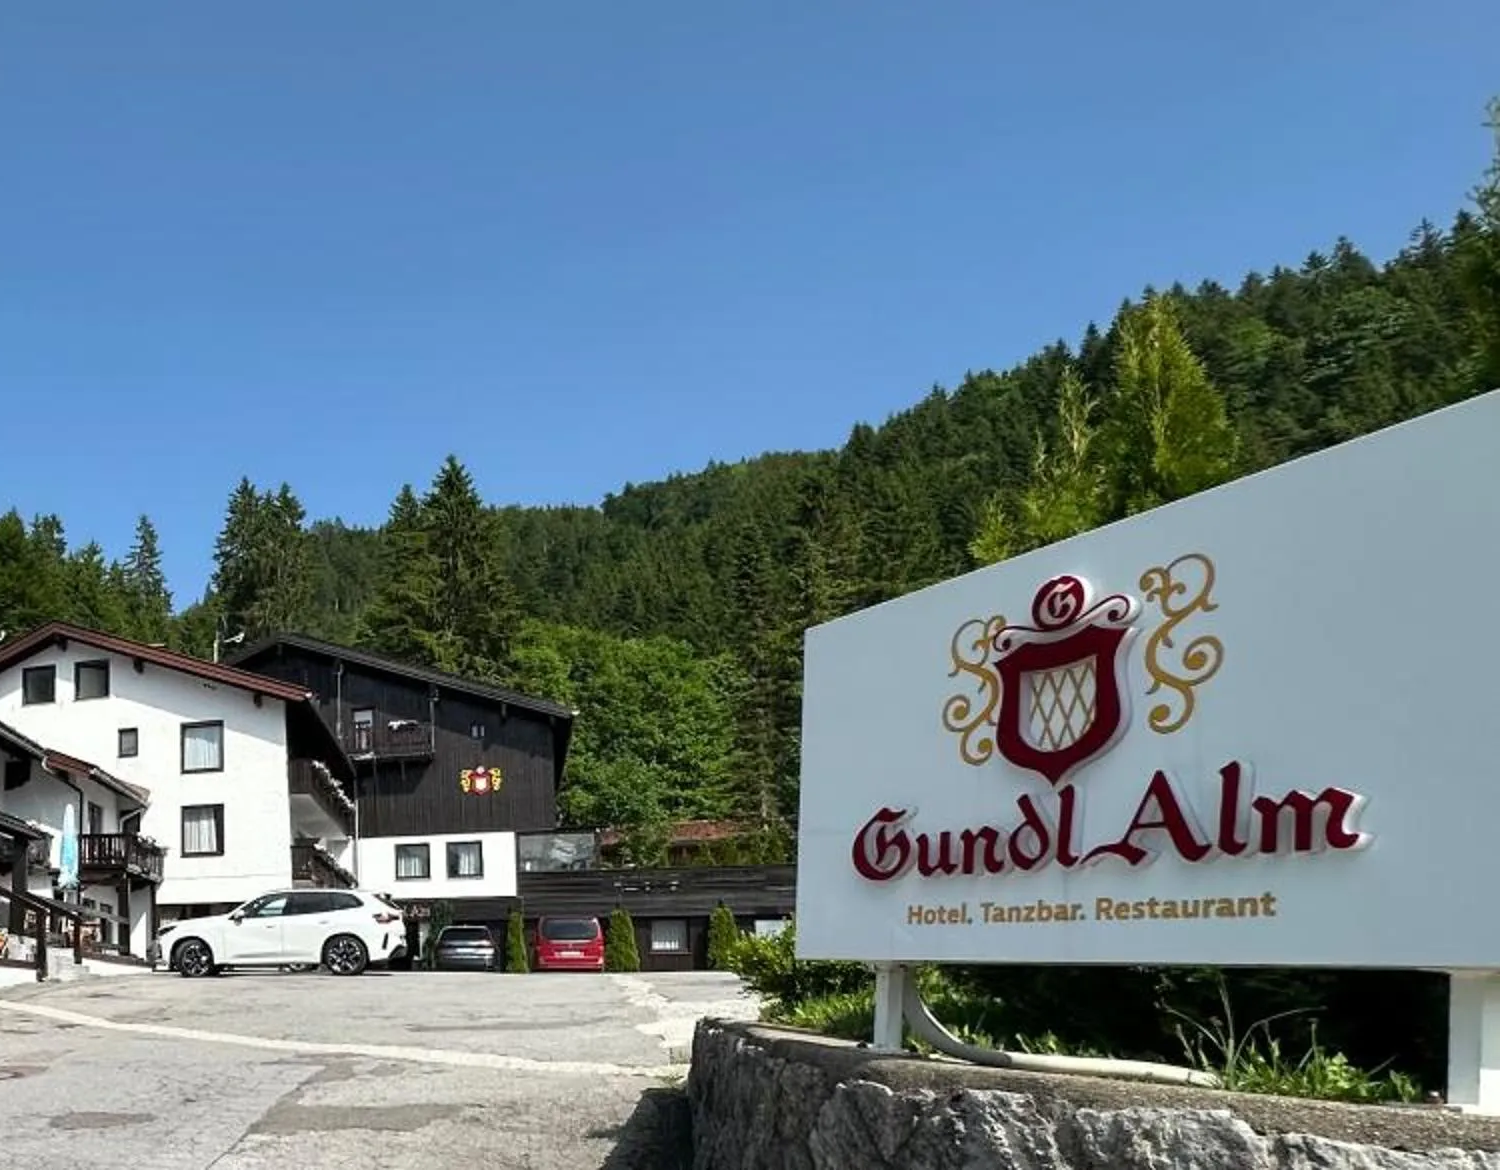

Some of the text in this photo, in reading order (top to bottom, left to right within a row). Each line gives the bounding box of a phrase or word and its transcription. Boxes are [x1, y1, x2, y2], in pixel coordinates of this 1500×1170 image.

[852, 761, 1360, 881] Gundl Alm
[907, 892, 1276, 925] Hotel. Tanzbar. Restaurant
